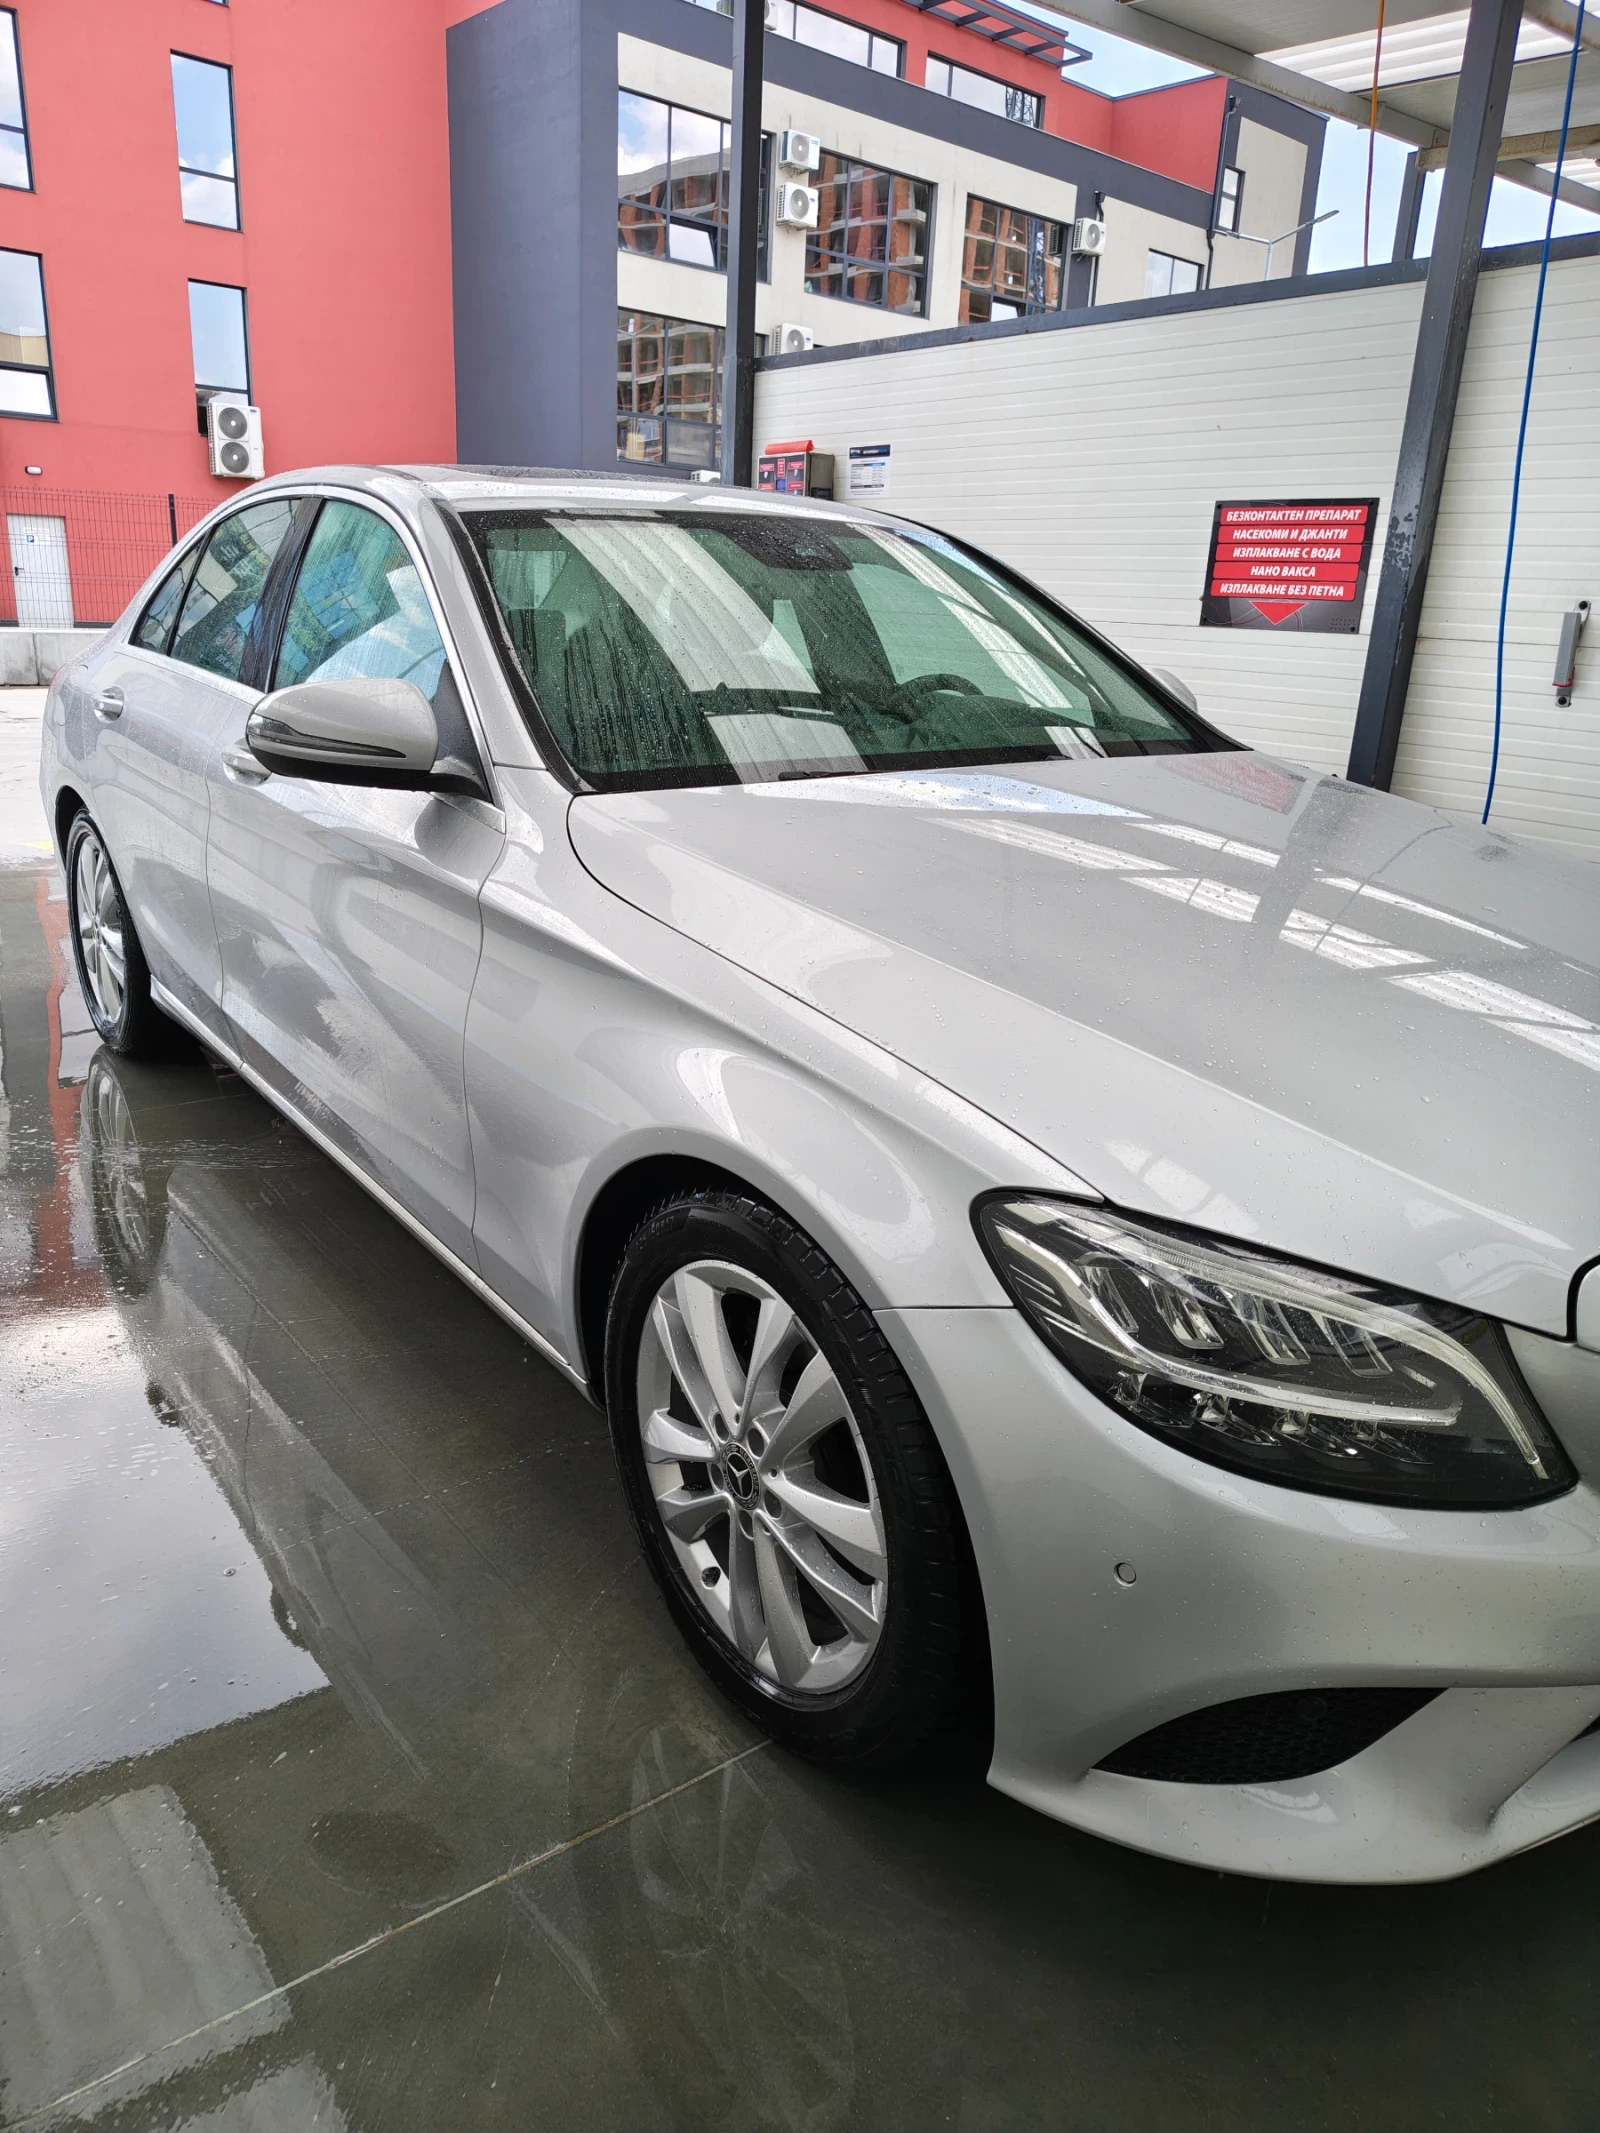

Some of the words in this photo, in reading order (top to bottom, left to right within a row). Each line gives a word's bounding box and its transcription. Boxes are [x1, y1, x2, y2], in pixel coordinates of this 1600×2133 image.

[1226, 510, 1303, 522] БЕЗКОНТАКТЕН
[1304, 509, 1362, 521] ПРЕПАРАТ
[1233, 529, 1289, 540] НАСЕКОМИ
[1290, 529, 1298, 540] И
[1298, 528, 1348, 541] ДЖАНТИ
[1233, 547, 1300, 559] ИЗПЛАКВАНЕ
[1302, 547, 1309, 559] С
[1310, 548, 1341, 561] ВОДА
[1250, 565, 1281, 577] НАНО
[1281, 566, 1316, 577] ВАКСА
[1220, 583, 1286, 595] ИЗПЛАКВАНЕ
[1287, 584, 1307, 596] БЕЗ
[1308, 585, 1344, 597] ПЕТНА
